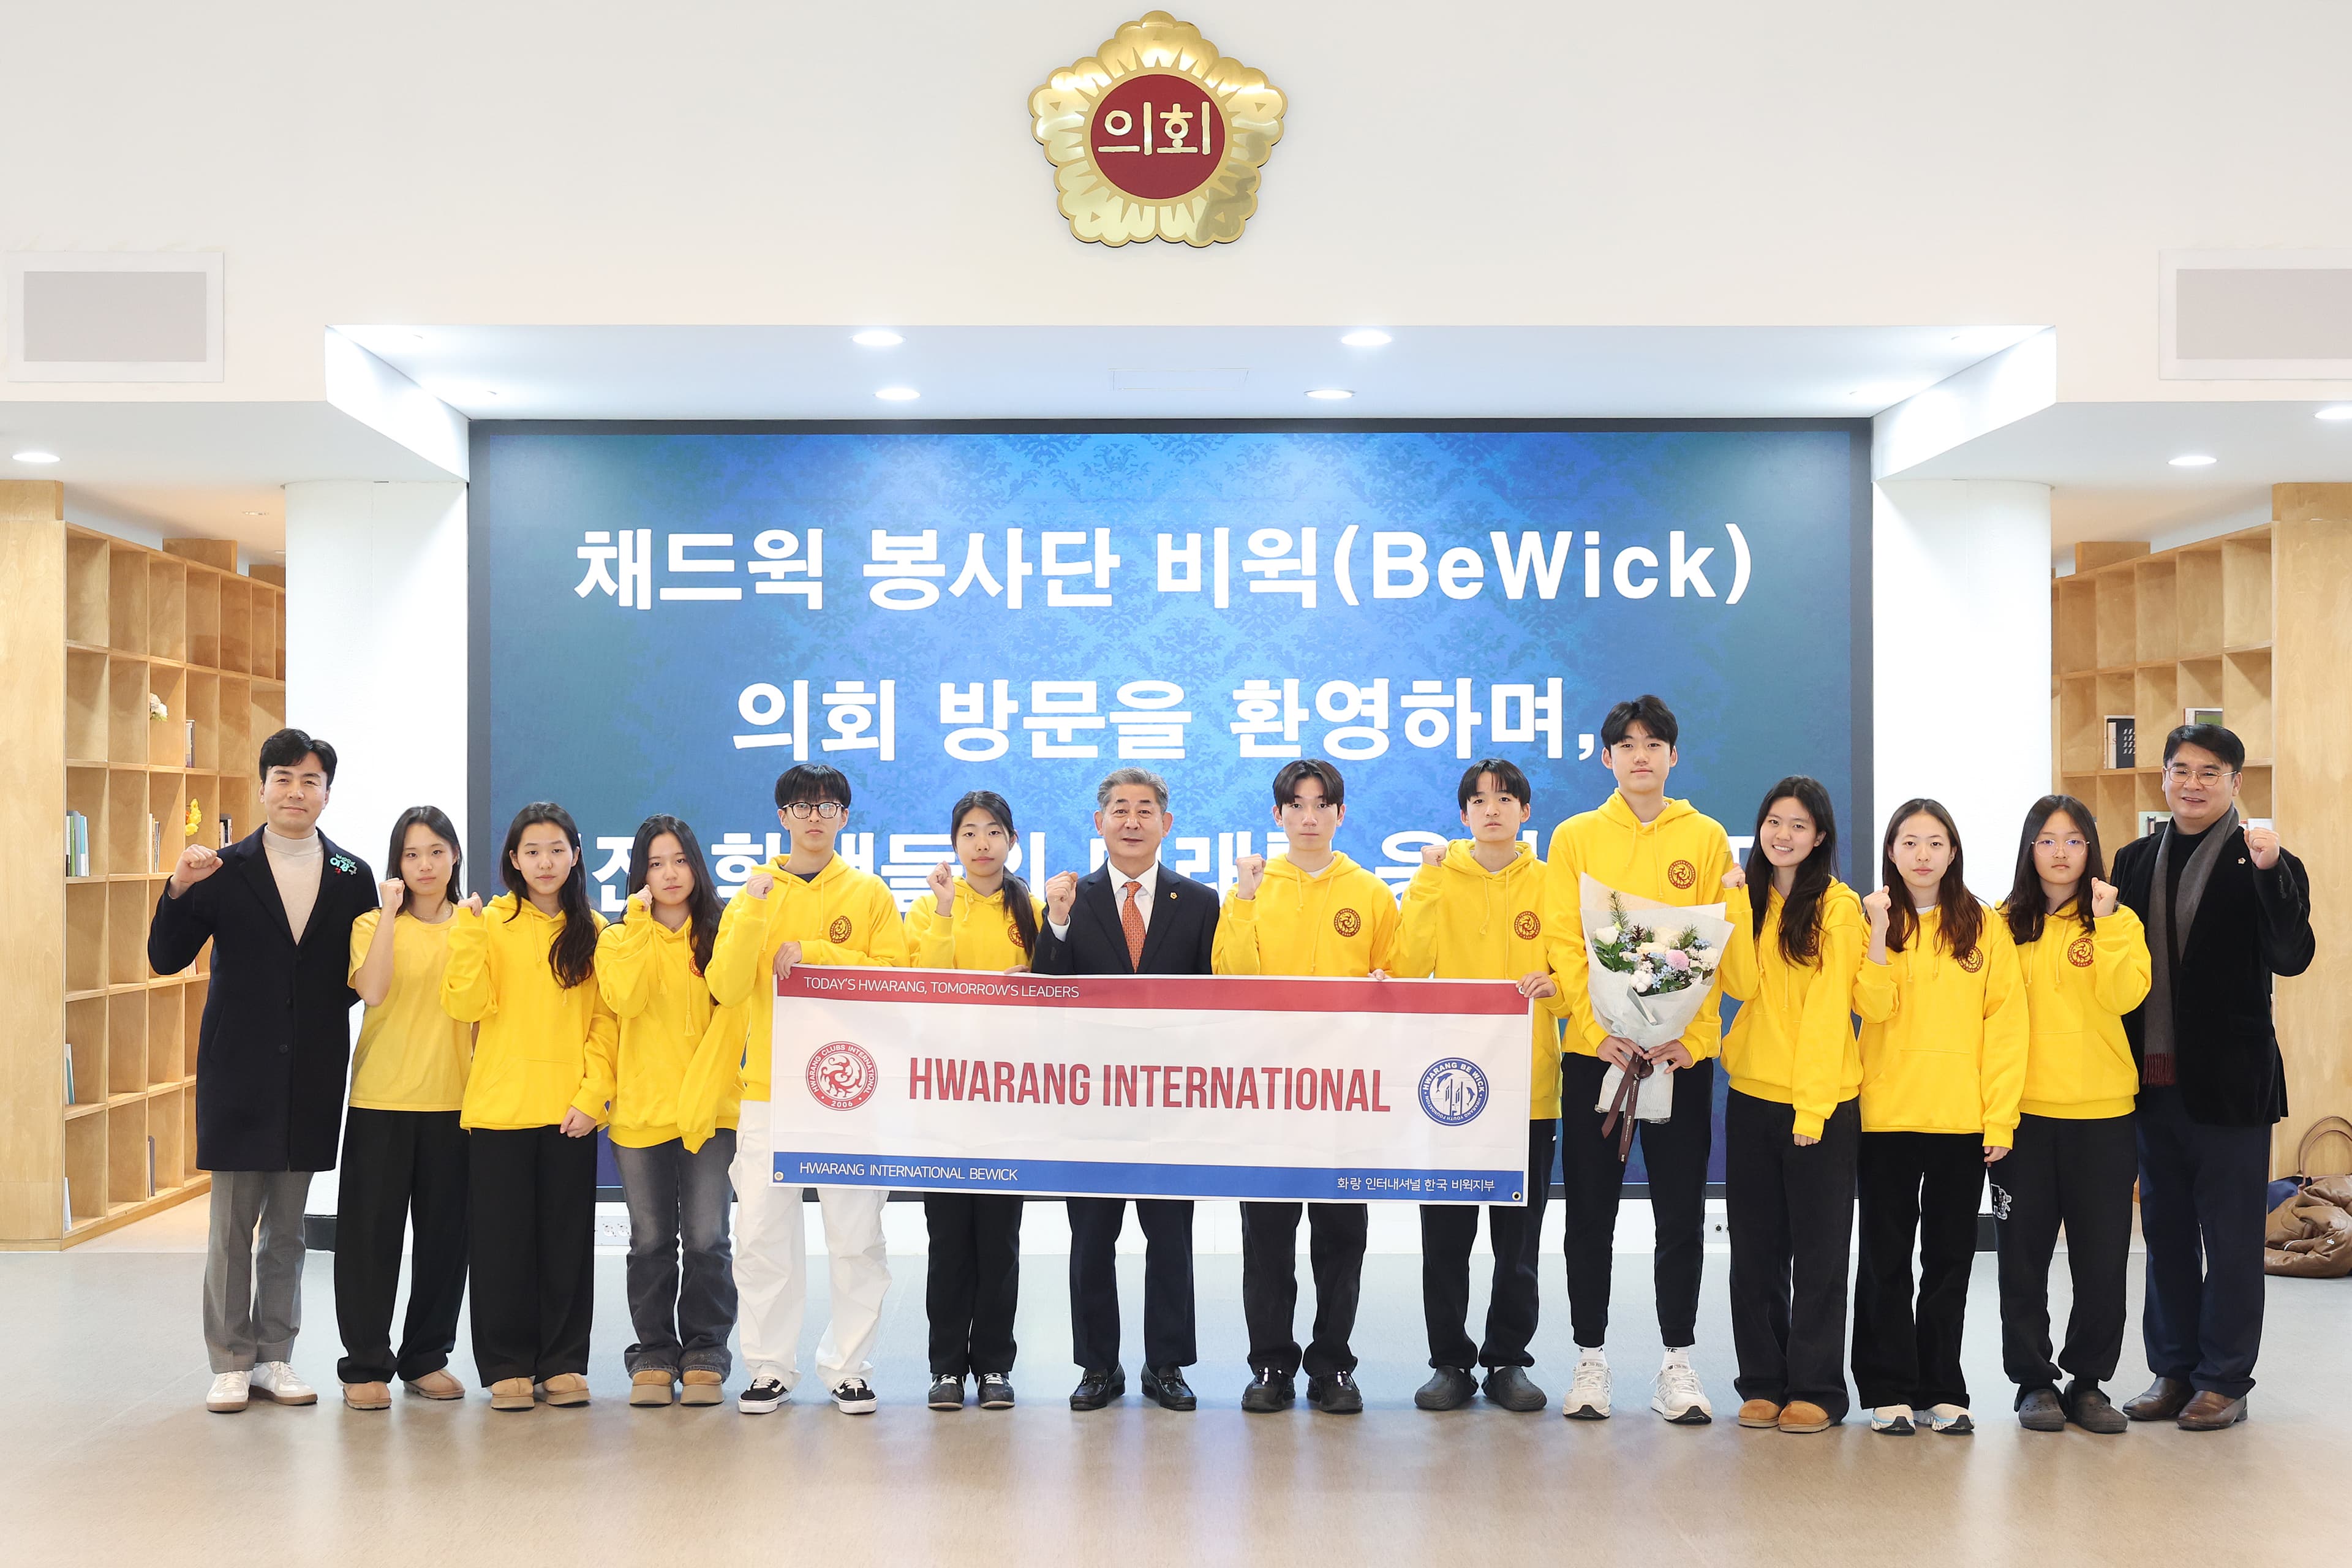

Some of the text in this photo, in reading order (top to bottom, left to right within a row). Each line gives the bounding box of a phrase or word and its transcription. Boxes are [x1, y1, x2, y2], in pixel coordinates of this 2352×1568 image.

[1097, 101, 1211, 156] 의회
[575, 524, 1751, 610] 채드윅 봉사단 비윅(BeWick)
[733, 677, 1595, 761] 의회 방문을 환영하며,
[804, 976, 1080, 998] TODAY'S HWARANG, TOMORROW'S LEADERS
[808, 1044, 875, 1094] HWARANG CLUBS INTERNATIONAL
[909, 1057, 1391, 1112] HWARANG INTERNATIONAL
[1422, 1062, 1485, 1093] HWARANG BE WICK
[799, 1161, 1018, 1181] HWARANG INTERNATIONAL BEWICK
[1337, 1177, 1495, 1193] 화랑 인터내셔널 한국 비윅지부
